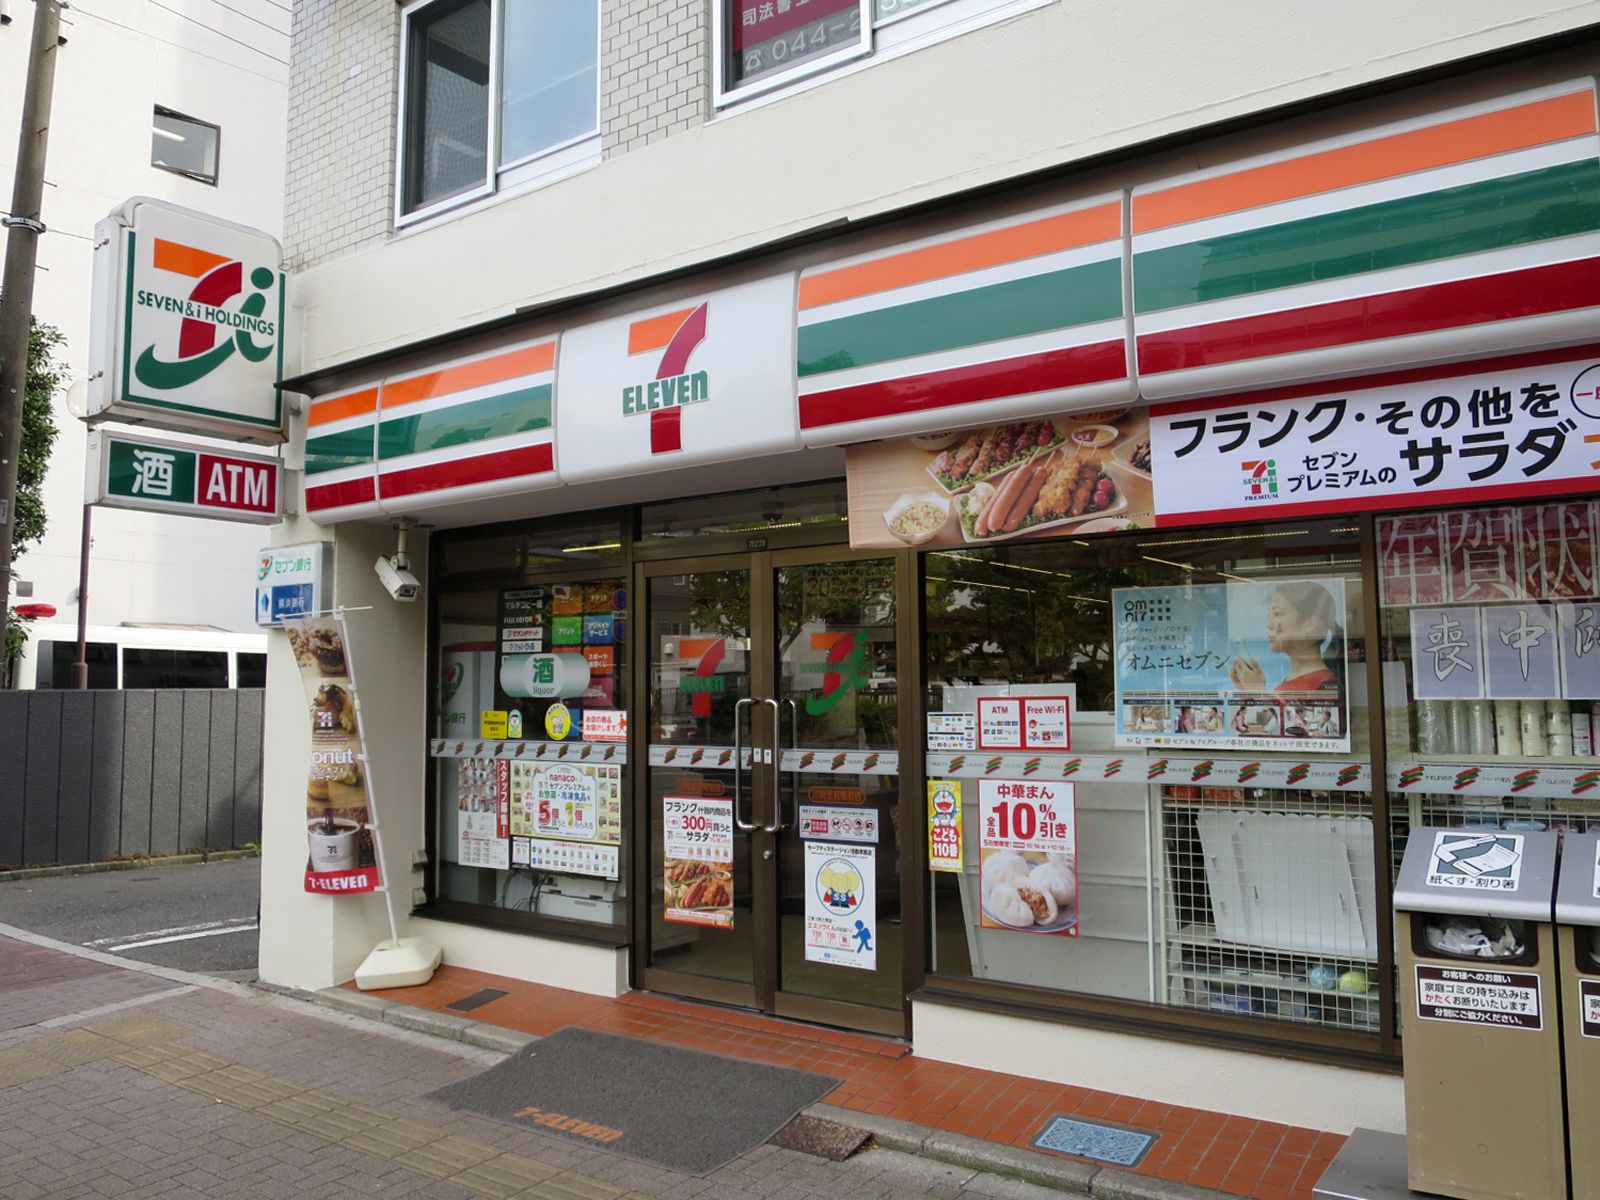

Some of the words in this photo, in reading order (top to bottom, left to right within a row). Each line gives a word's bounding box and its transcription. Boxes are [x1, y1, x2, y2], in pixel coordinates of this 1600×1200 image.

[205, 306, 275, 336] HOLDINGS
[1302, 451, 1358, 472] セブン
[1399, 418, 1578, 487] サラダ
[131, 448, 175, 495] 酒
[1288, 466, 1397, 494] プレミアムの
[206, 462, 268, 507] ATM
[1244, 493, 1280, 502] PREMIUM
[532, 657, 555, 684] 酒
[532, 686, 555, 697] liquor
[991, 705, 1009, 714] ATM
[1026, 706, 1043, 714] Free
[1044, 705, 1065, 714] Wi-Fi
[549, 774, 576, 782] nanaco
[997, 784, 1055, 799] 中華まん
[933, 828, 958, 842] こども
[986, 816, 997, 838] 全品
[1039, 822, 1068, 839] 引き
[686, 832, 710, 843] サラダ
[833, 893, 847, 902] SS
[1441, 970, 1512, 983] お客様へのお願い
[1424, 982, 1530, 1000] 家庭ゴミの持ち込みは
[1425, 993, 1533, 1013] かたくお断りいたします。
[1434, 1007, 1523, 1025] 分別にご協力ください。
